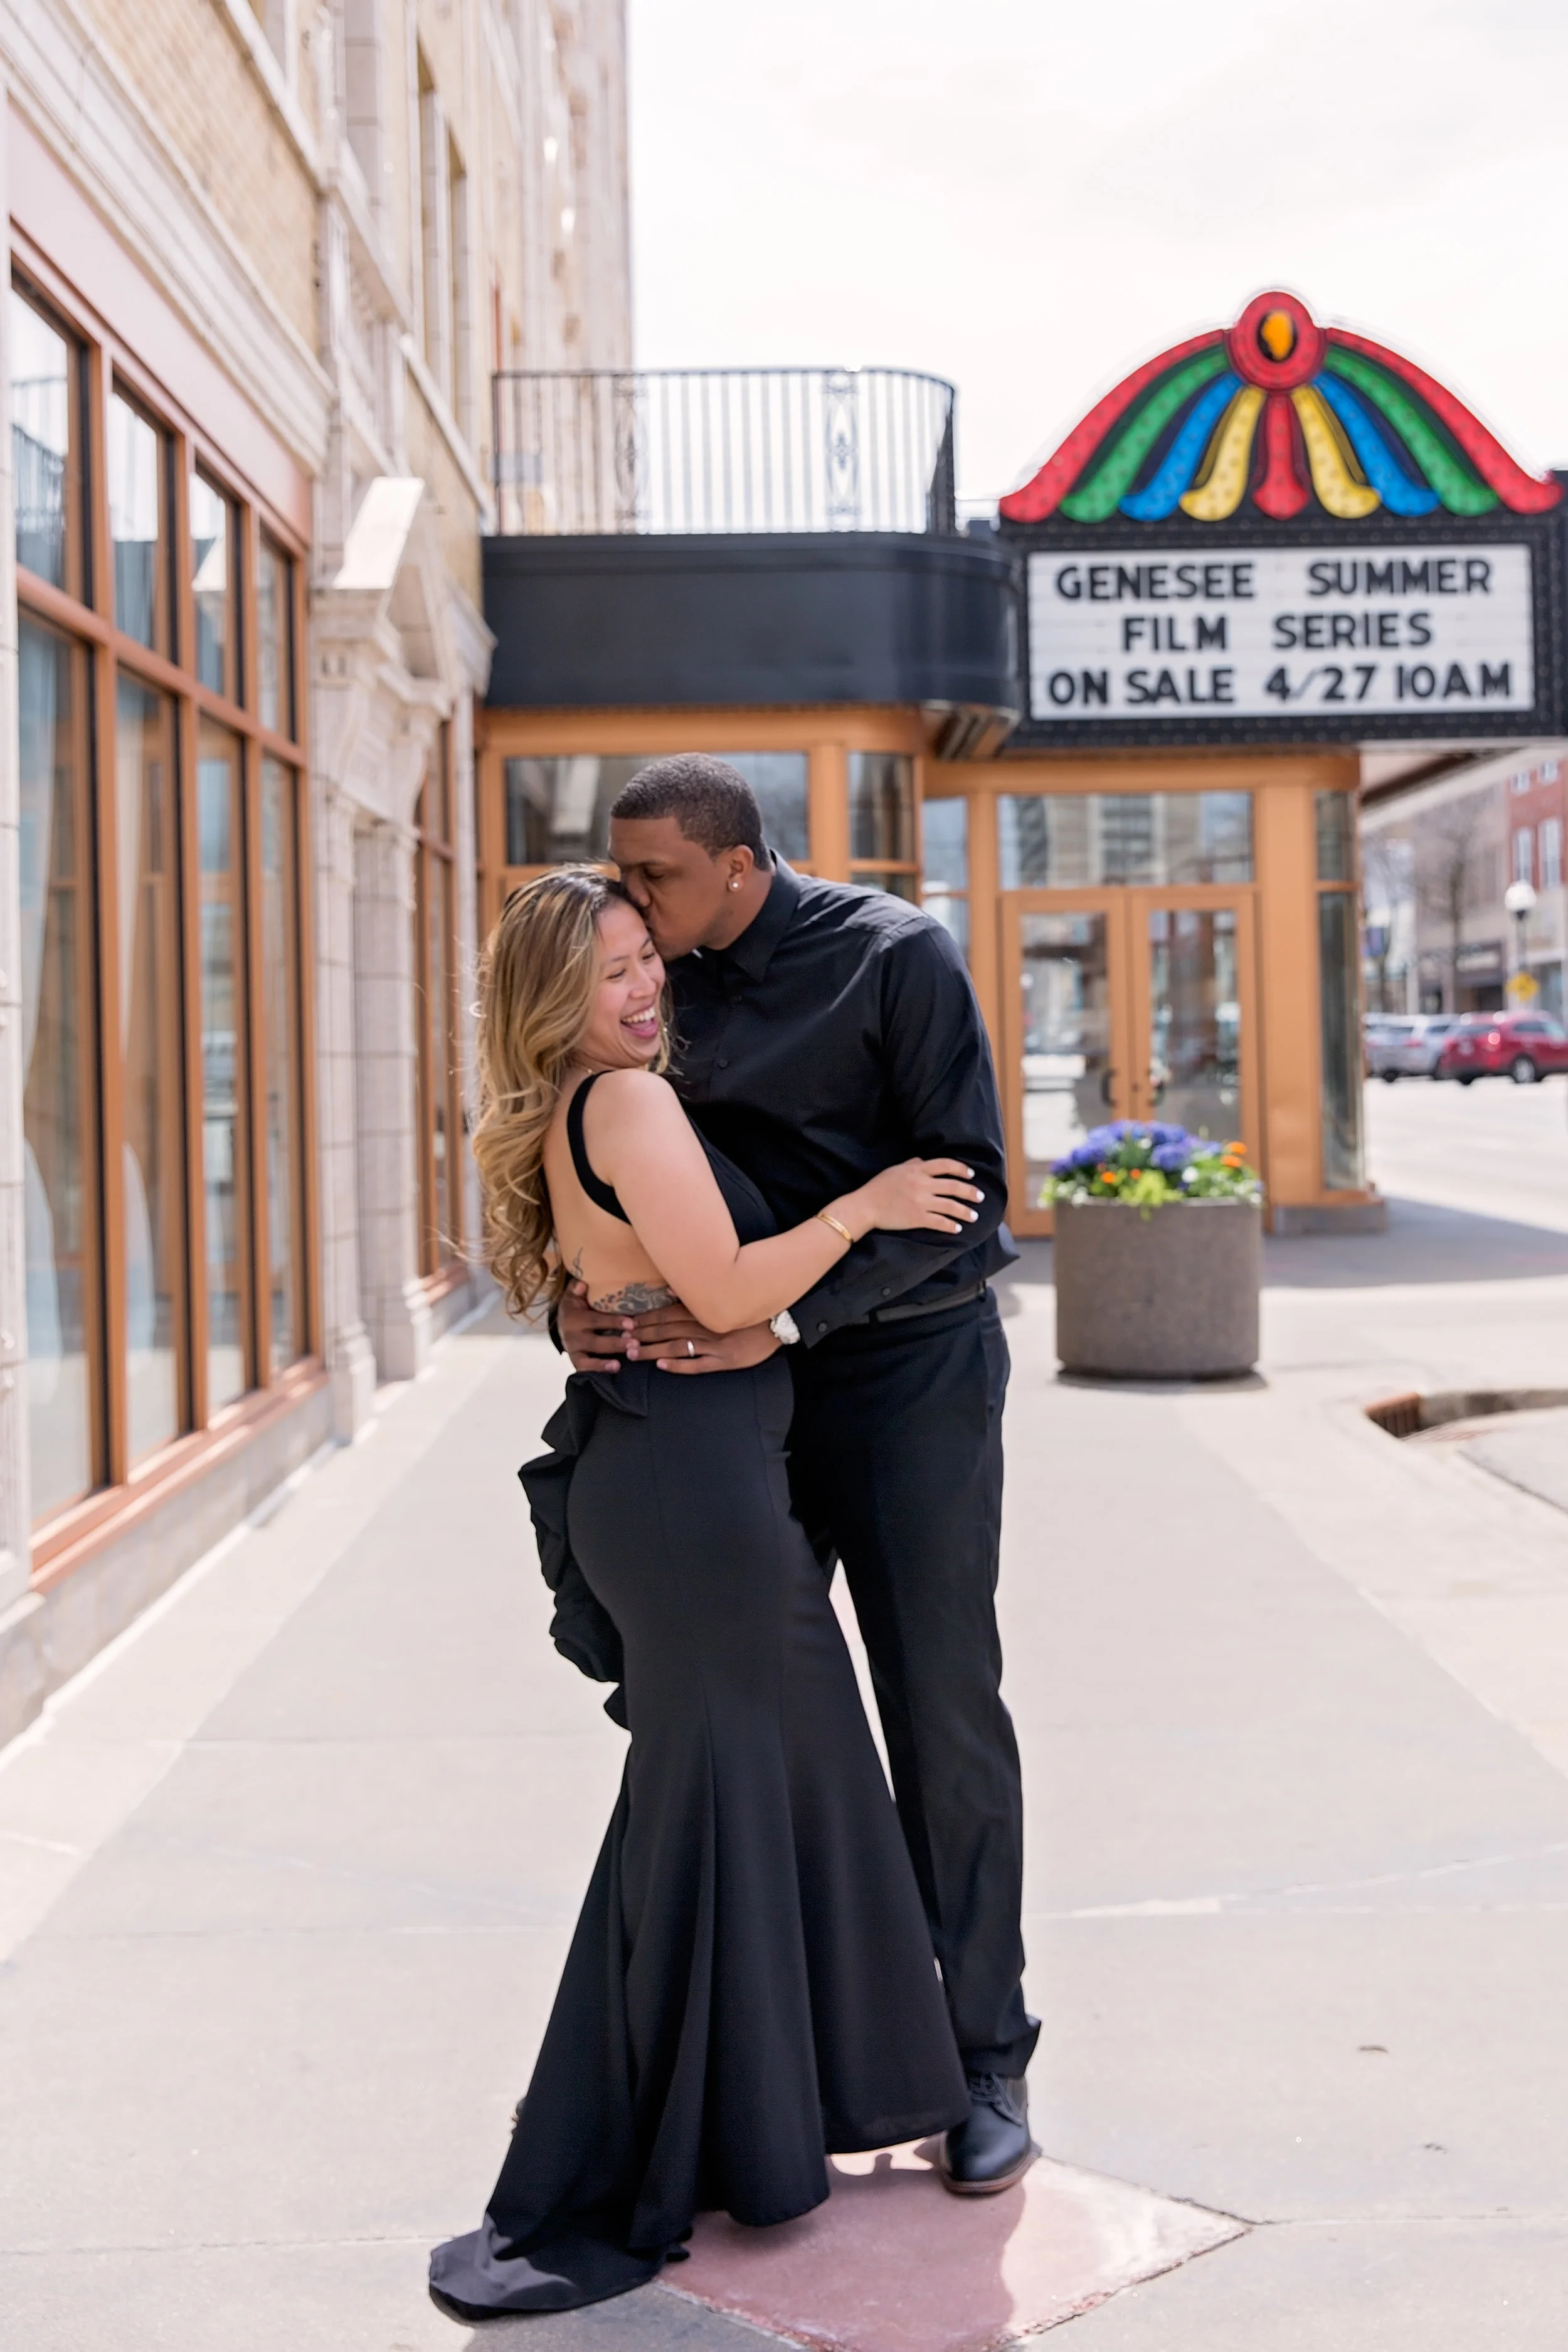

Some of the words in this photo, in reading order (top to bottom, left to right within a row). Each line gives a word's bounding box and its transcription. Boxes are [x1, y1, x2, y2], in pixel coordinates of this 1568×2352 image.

[1055, 562, 1255, 602] GENESEE
[1307, 558, 1491, 597] SUMMER
[1122, 615, 1227, 653] FILM
[1273, 612, 1432, 650] SERIES
[1047, 669, 1110, 707] ON
[1125, 667, 1235, 706] SALE
[1264, 664, 1377, 702] 4/27
[1396, 662, 1512, 701] 10AM
